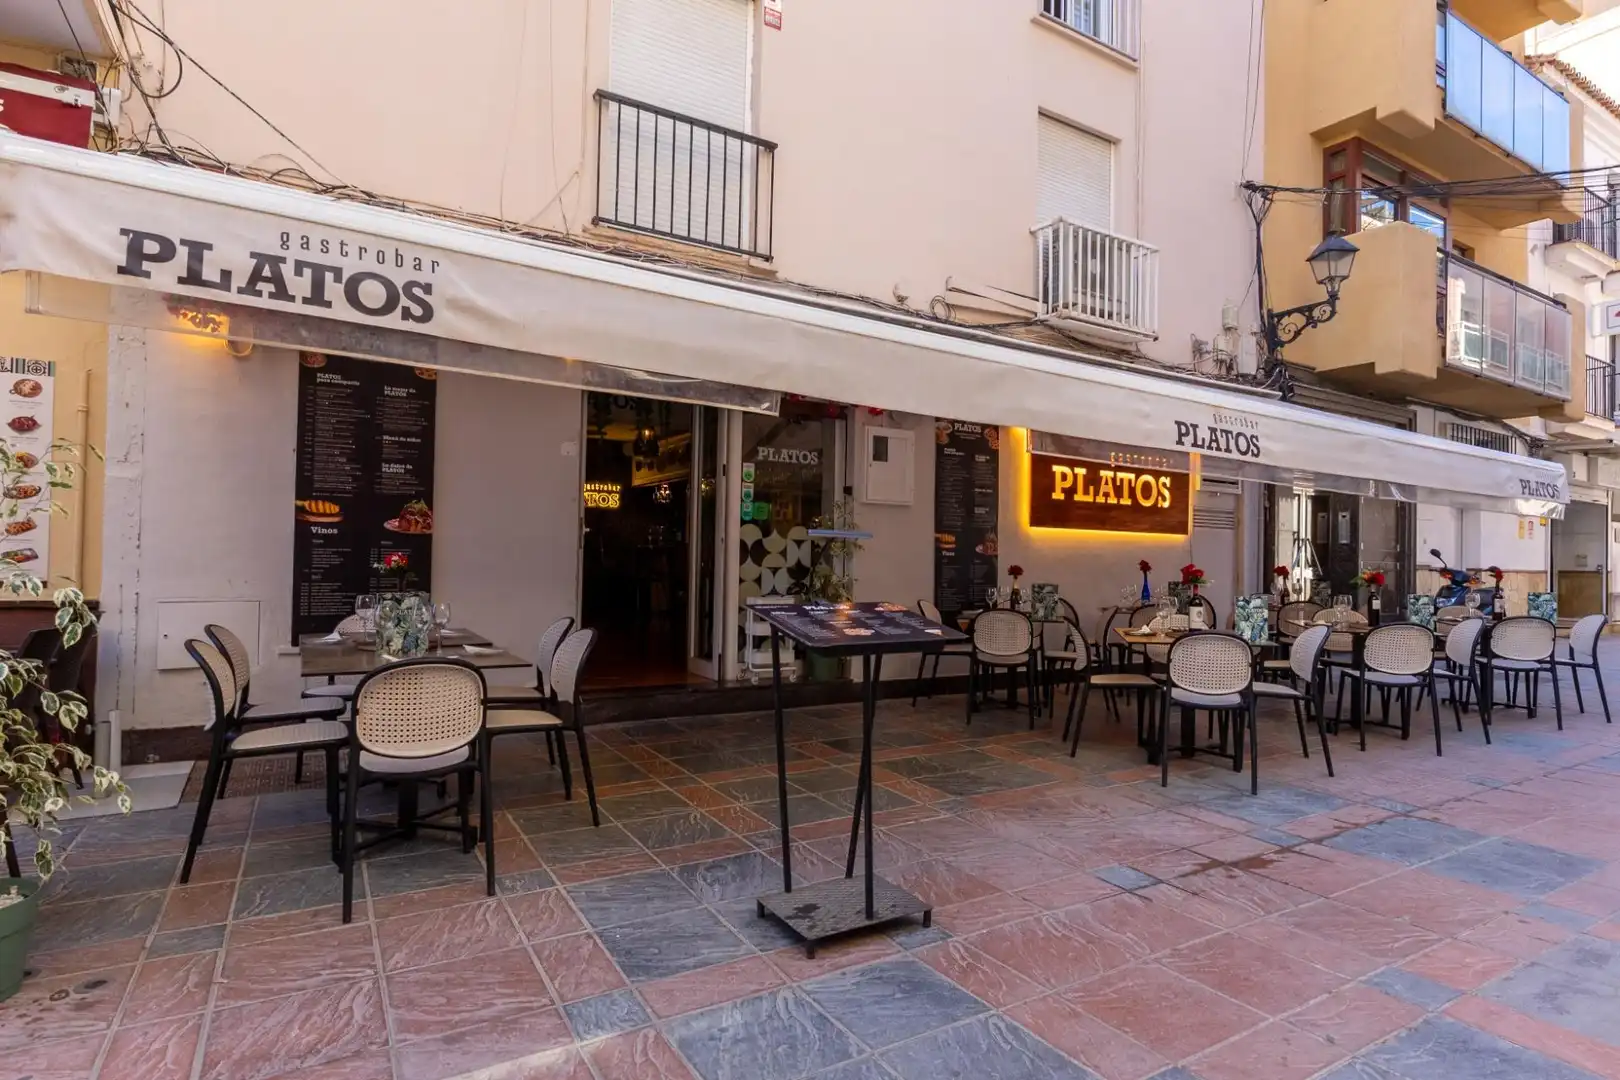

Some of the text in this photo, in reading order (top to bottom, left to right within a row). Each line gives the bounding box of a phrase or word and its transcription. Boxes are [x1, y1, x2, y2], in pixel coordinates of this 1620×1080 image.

[279, 231, 440, 275] gastrobar
[116, 227, 435, 325] PLATOS
[954, 422, 982, 433] PLATOS
[1174, 420, 1261, 458] PLATOS
[756, 446, 819, 465] PLATOS
[1051, 464, 1172, 509] PLATOS
[1519, 478, 1561, 500] PLATOS
[310, 526, 339, 534] Vinos
